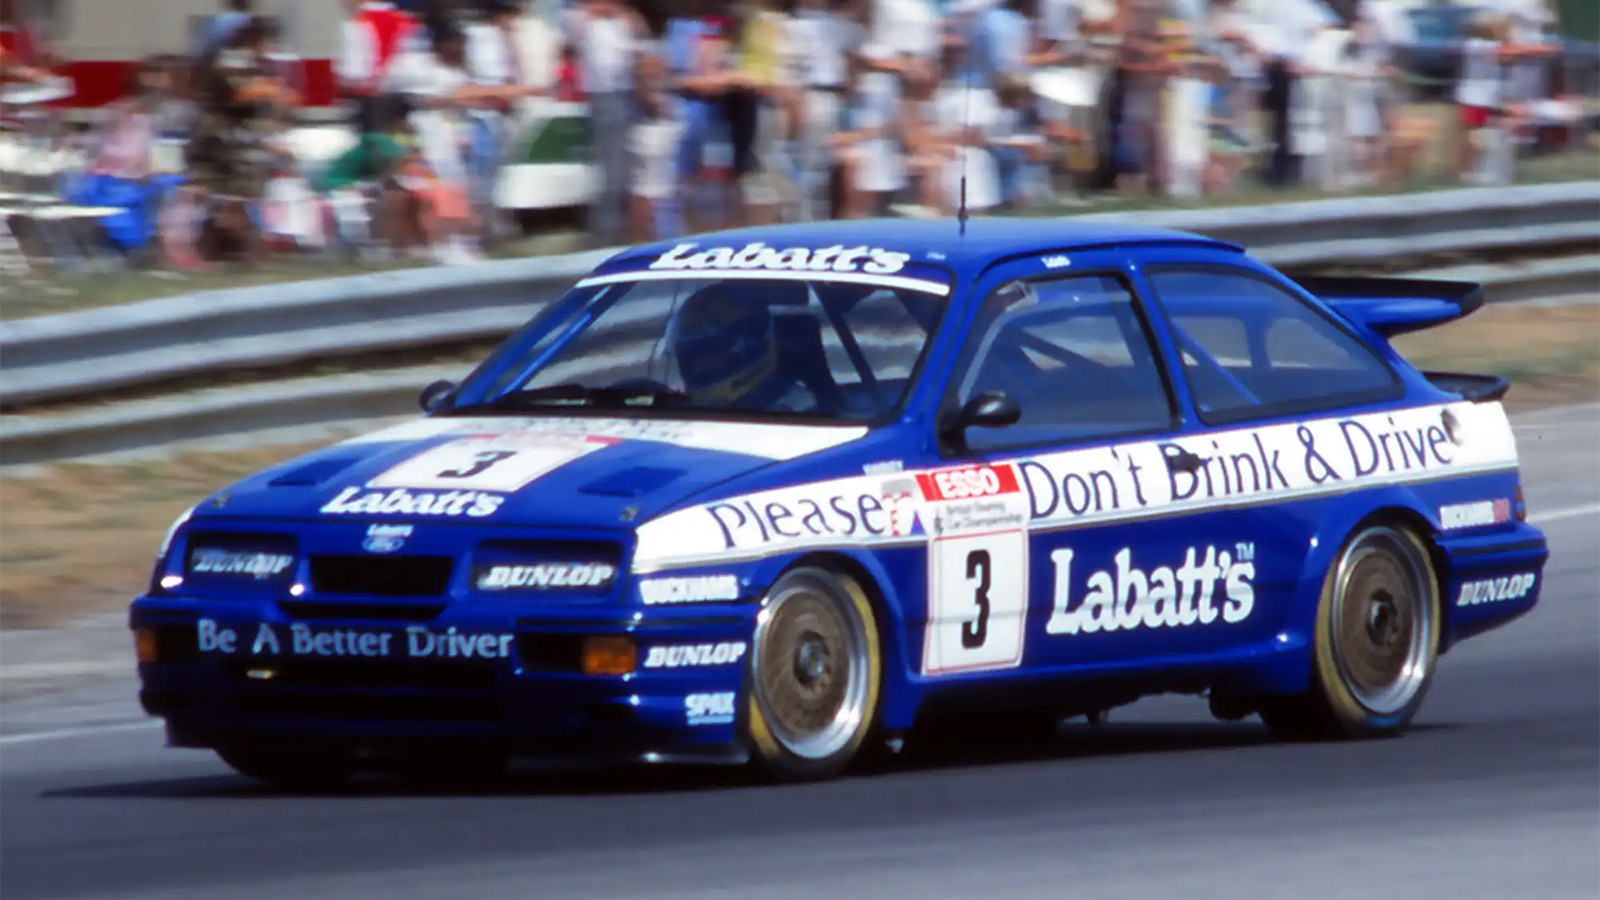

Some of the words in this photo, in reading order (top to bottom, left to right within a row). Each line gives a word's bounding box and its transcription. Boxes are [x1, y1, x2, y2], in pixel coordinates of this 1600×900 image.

[650, 242, 910, 274] Labatt's
[436, 450, 518, 478] 3
[1018, 446, 1147, 519] Don't
[1158, 432, 1290, 502] Brink
[1296, 424, 1342, 484] &
[1338, 416, 1453, 478] Drive
[934, 467, 1000, 499] ESSO
[321, 486, 505, 517] Labatt's
[705, 493, 885, 548] Please
[482, 563, 613, 588] DUNLOP
[1046, 545, 1255, 635] Labatt's
[1456, 572, 1535, 607] DUNLOP
[960, 548, 992, 649] 3
[198, 618, 238, 653] Be
[252, 623, 280, 654] A
[290, 622, 392, 656] Better
[406, 626, 514, 657] Driver
[643, 641, 747, 668] DUNLOP
